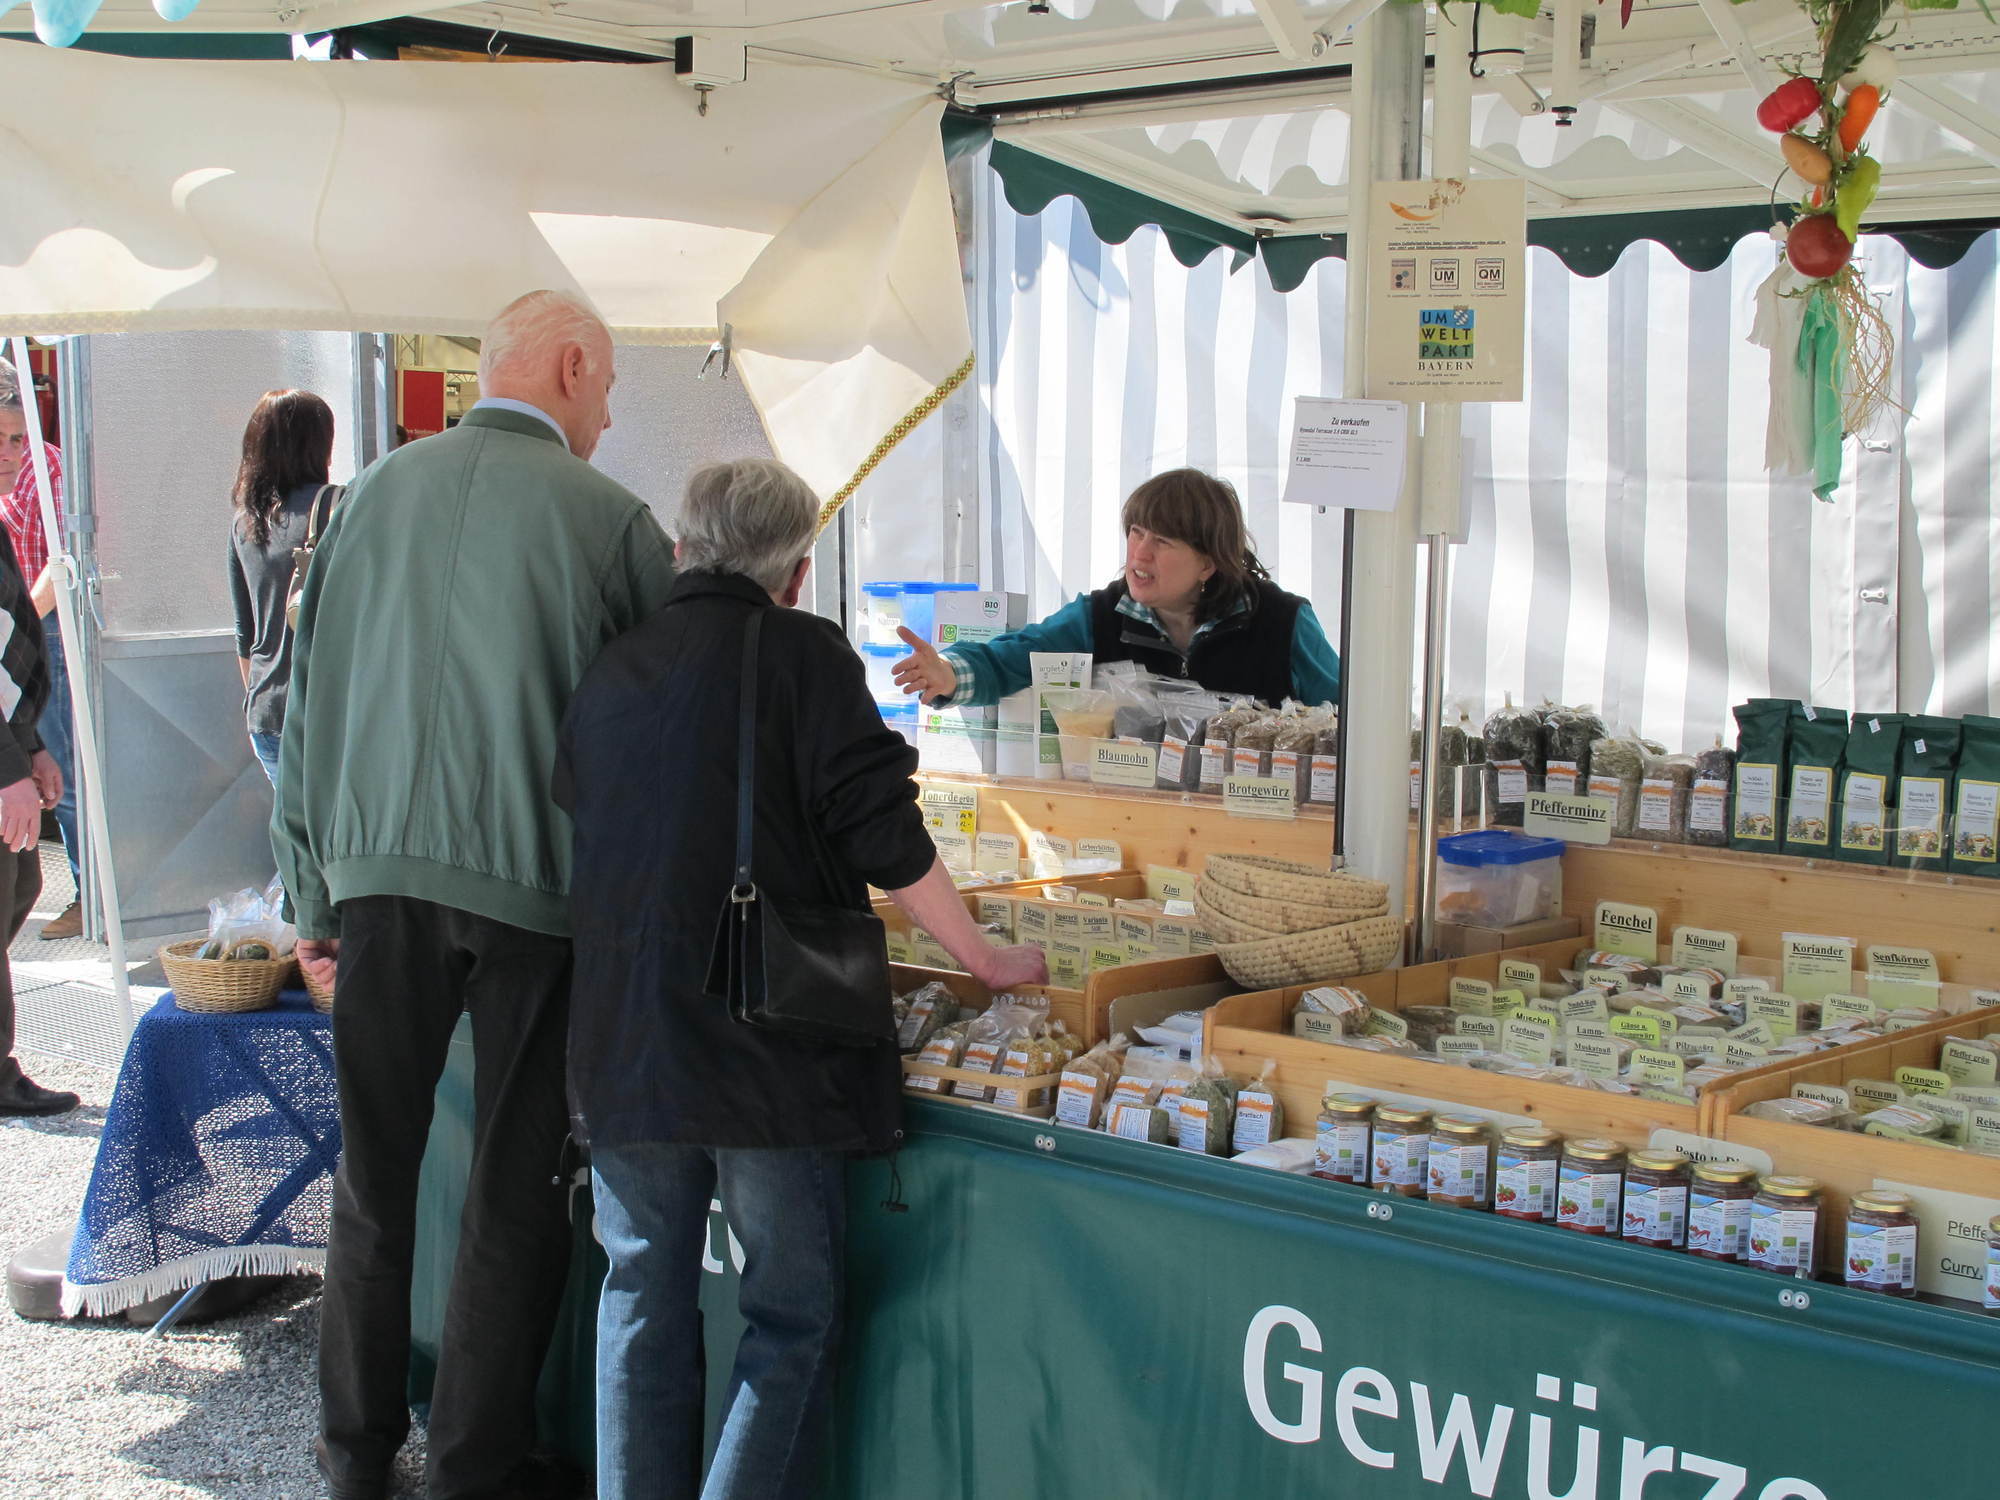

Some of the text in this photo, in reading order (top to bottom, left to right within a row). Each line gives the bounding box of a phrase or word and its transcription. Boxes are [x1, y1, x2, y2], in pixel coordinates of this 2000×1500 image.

[1434, 270, 1454, 281] UM
[1478, 268, 1500, 279] QM
[1422, 311, 1448, 324] UM
[1421, 327, 1471, 340] WELT
[1421, 344, 1471, 357] PAKT
[1418, 361, 1474, 371] BAYERN
[1331, 417, 1370, 427] Zu verkaufen
[984, 601, 999, 609] BIO
[1098, 747, 1149, 765] Blaumohn
[923, 789, 958, 802] Tonerde
[1228, 782, 1290, 799] Brotgewürz
[1531, 798, 1607, 819] Pfefferminz
[1162, 883, 1181, 895] Zimt
[1601, 909, 1652, 930] Fenchel
[1685, 933, 1726, 949] Kümmel
[1792, 942, 1843, 956] Koriander
[1872, 951, 1930, 966] Senfkörner
[1505, 966, 1535, 980] Cumin
[1675, 983, 1697, 994] Anis
[1306, 1018, 1332, 1029] Nelken
[1461, 1020, 1495, 1032] Bratfisch
[1576, 1024, 1605, 1036] Lamm-
[1902, 1072, 1945, 1088] Orangen-
[1796, 1089, 1844, 1105] Rauchsalz
[1854, 1085, 1897, 1100] Curcuma
[1947, 1220, 1987, 1240] Pfeffe
[1243, 1305, 1829, 1500] Gewürz
